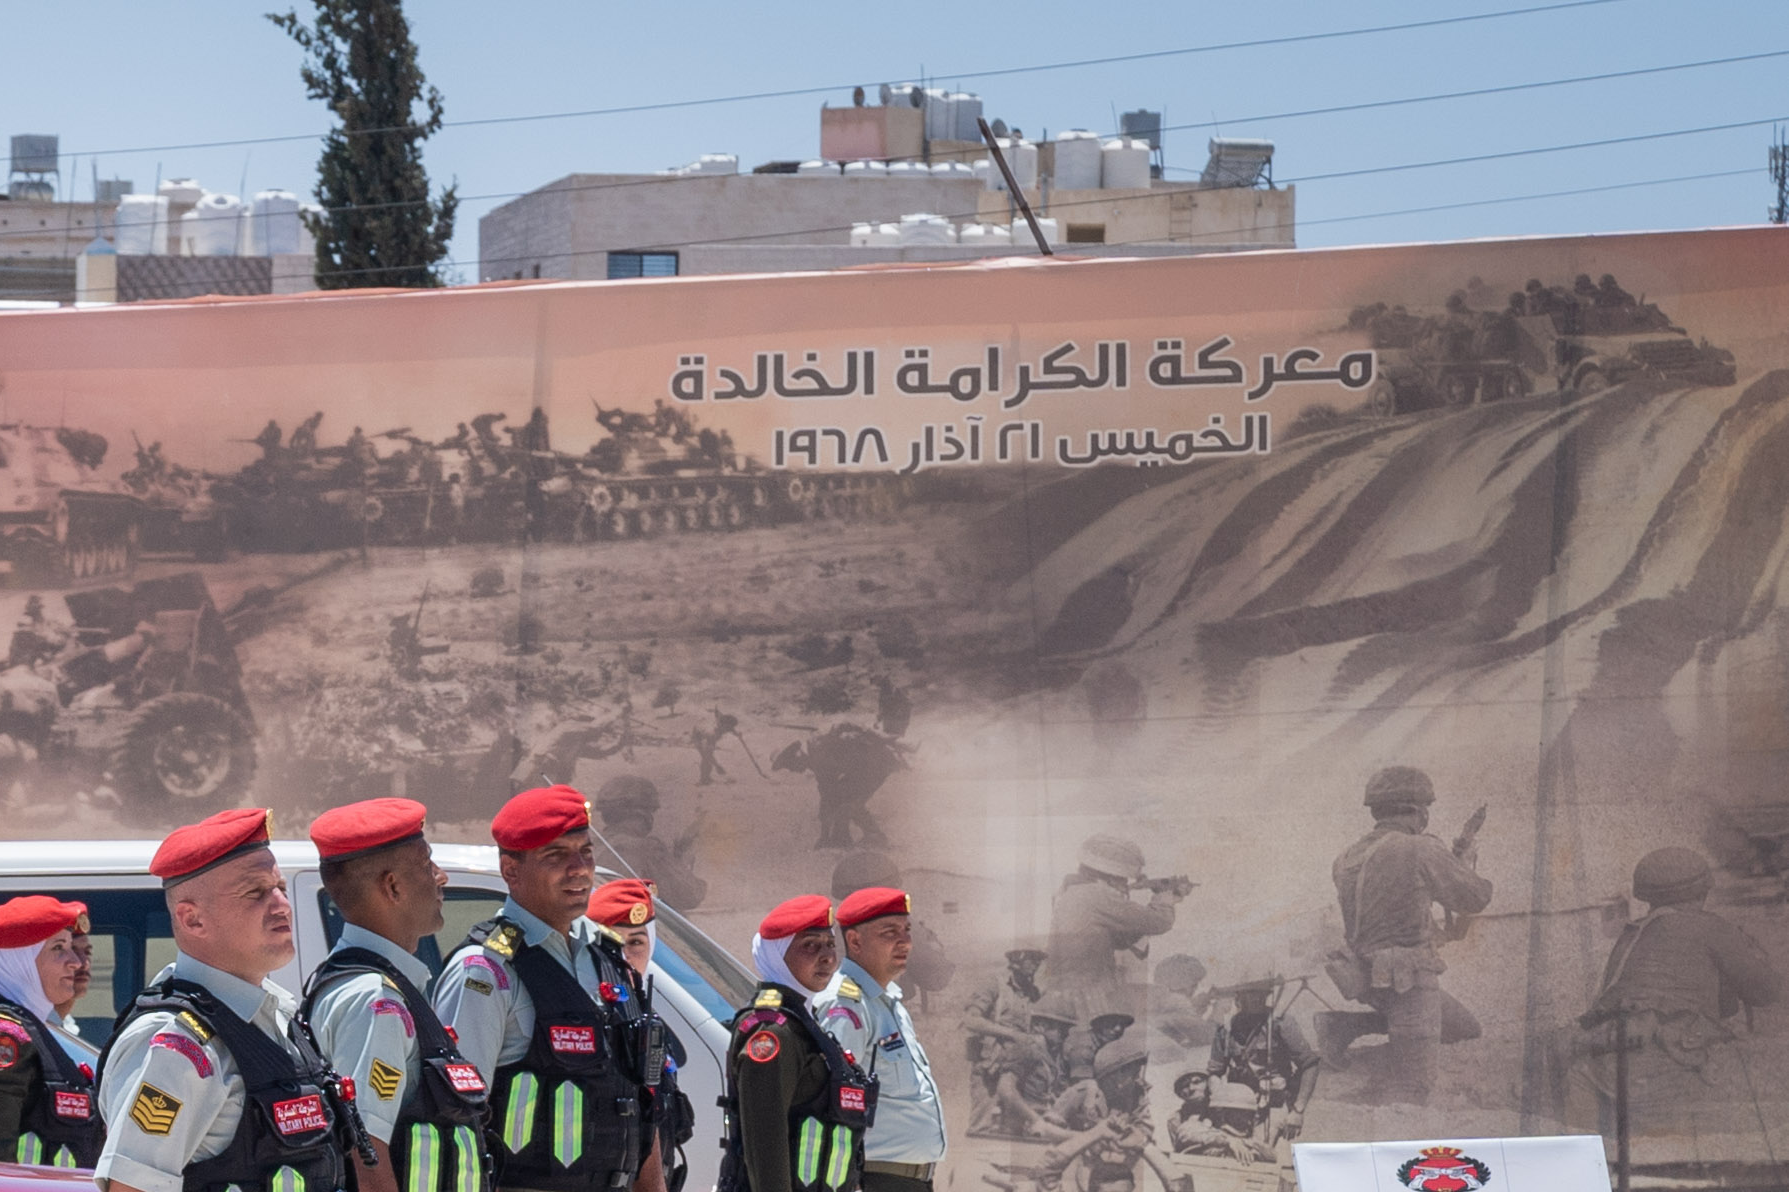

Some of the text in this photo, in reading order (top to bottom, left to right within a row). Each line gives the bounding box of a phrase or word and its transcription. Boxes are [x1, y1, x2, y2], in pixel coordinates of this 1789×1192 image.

[672, 336, 1374, 409] معركة الكرامة الخالدة
[774, 414, 1268, 476] الخميس ٢١ آذار ١٩٦٨
